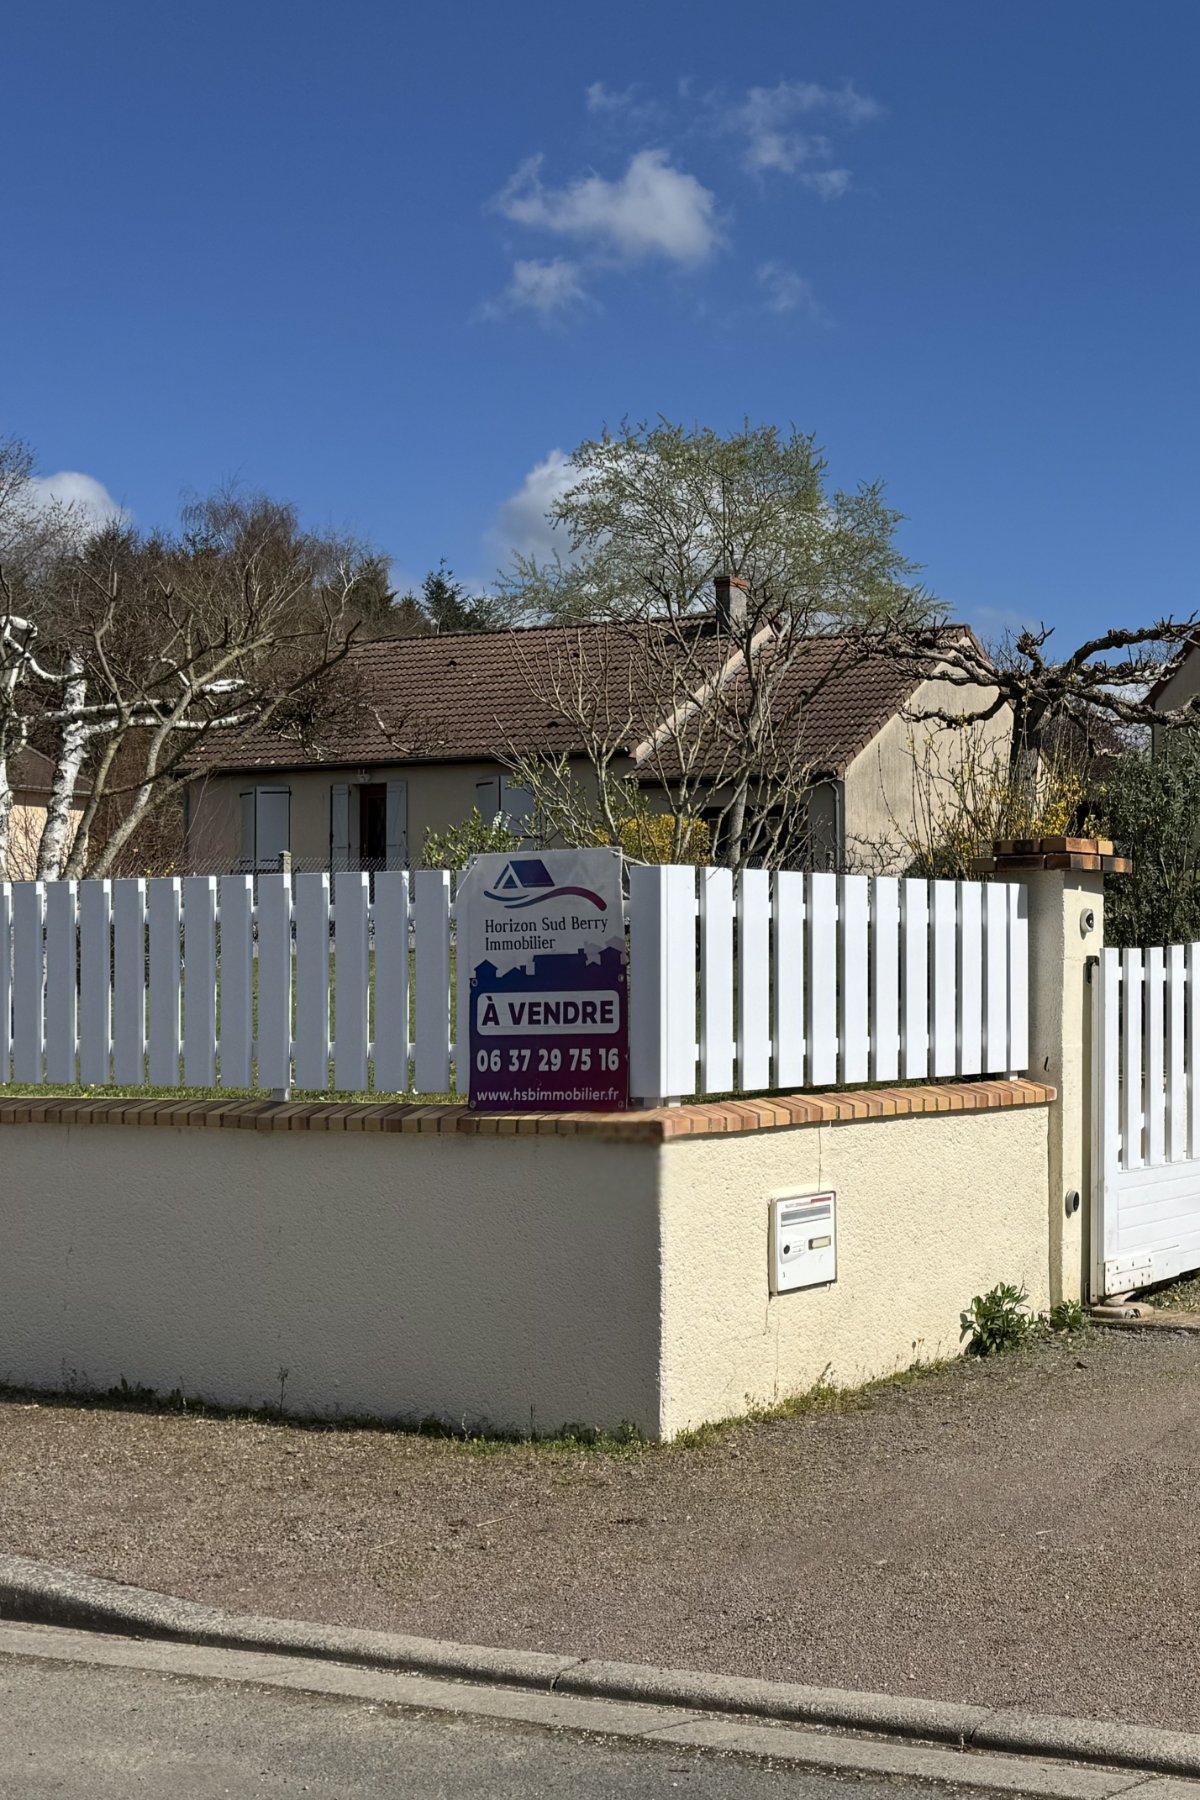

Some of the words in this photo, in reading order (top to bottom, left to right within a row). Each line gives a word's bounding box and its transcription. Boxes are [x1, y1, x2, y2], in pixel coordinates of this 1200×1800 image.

[485, 918, 538, 934] Horizon
[541, 916, 567, 932] Sud
[571, 915, 609, 933] Berry
[485, 935, 557, 951] Immobilier
[481, 995, 501, 1026] À
[508, 1000, 614, 1026] VENDRE
[476, 1049, 502, 1073] 06
[508, 1049, 532, 1072] 37
[538, 1048, 563, 1072] 29
[569, 1048, 592, 1072] 75
[598, 1047, 620, 1071] 16
[476, 1087, 620, 1102] www.hsbimmobilier.fr
